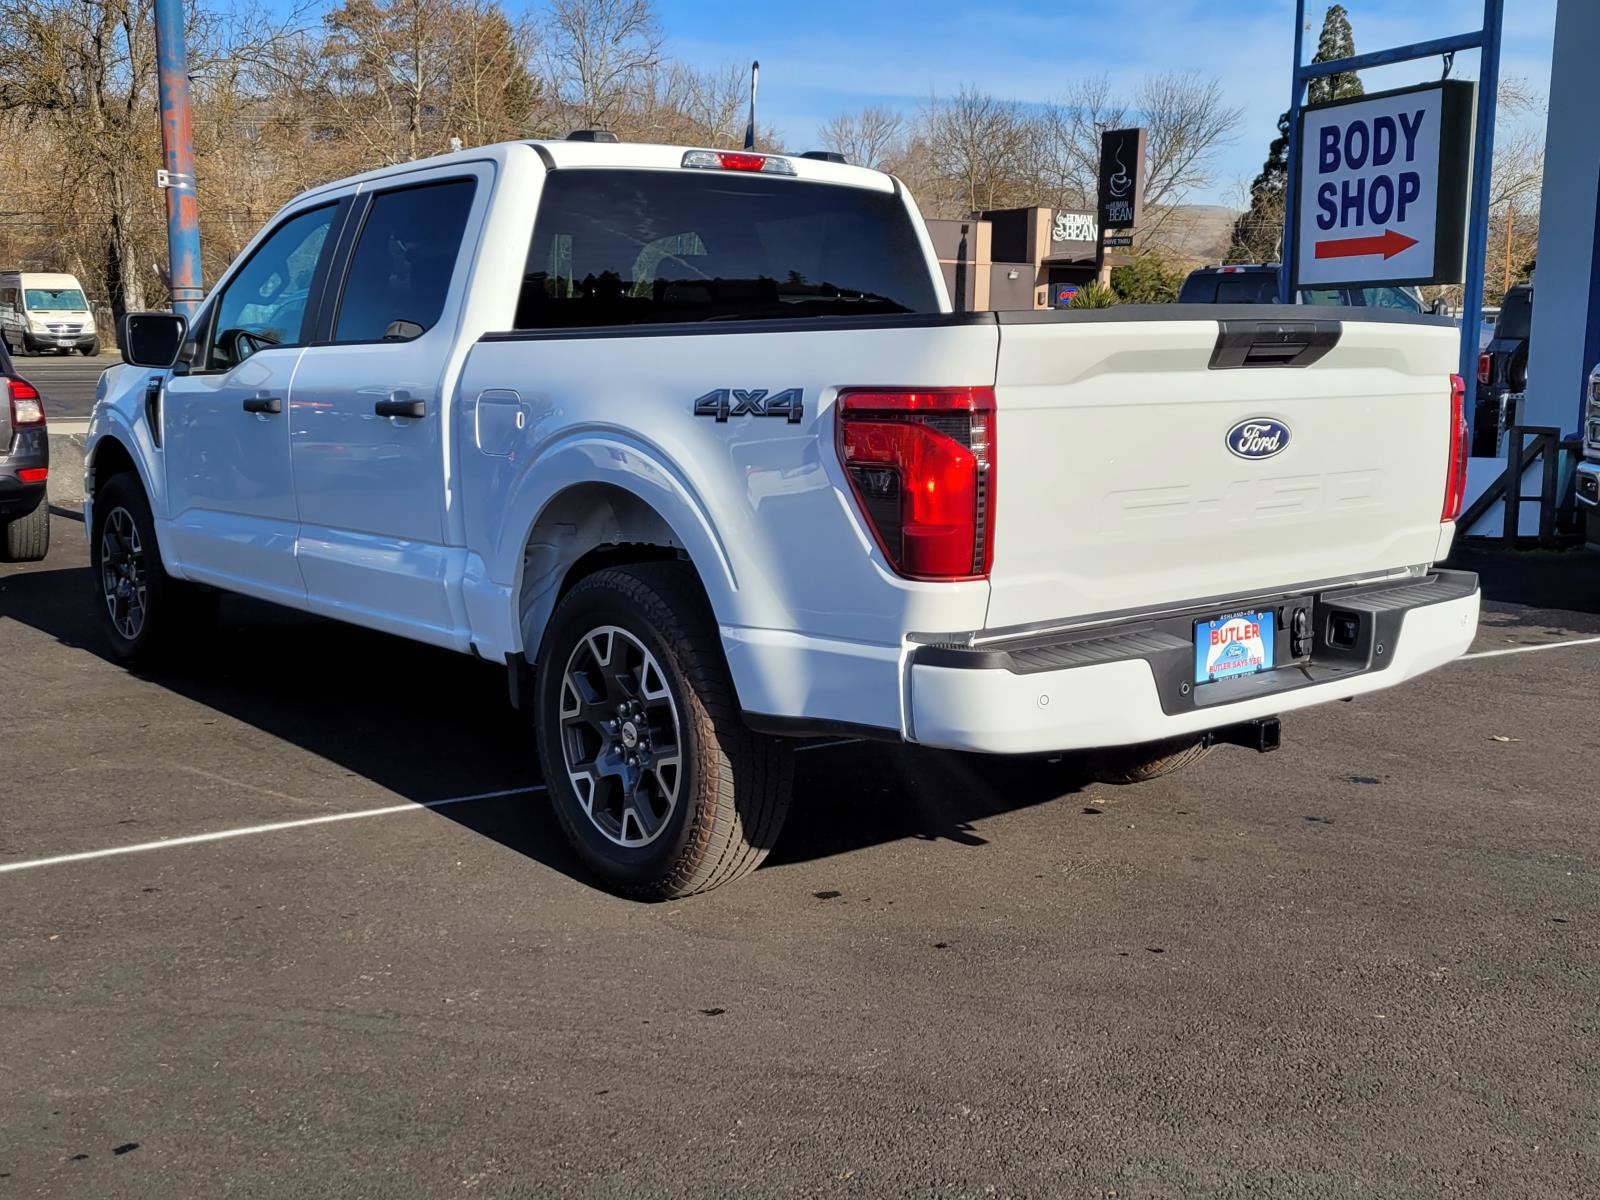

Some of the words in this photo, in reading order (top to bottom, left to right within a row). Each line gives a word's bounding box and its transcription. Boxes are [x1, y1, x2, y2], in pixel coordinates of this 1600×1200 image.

[1319, 109, 1426, 174] BODY
[1110, 201, 1128, 209] HUMAN
[1316, 172, 1420, 230] SHOP
[1066, 214, 1093, 224] HUMAN
[1109, 207, 1132, 221] BEAN
[1065, 224, 1098, 241] BEAN
[694, 388, 804, 424] 4X4
[1238, 424, 1281, 452] Ford
[1211, 623, 1260, 645] BUTLER
[1209, 663, 1231, 673] BUTLER
[1232, 660, 1248, 669] SAYS
[1249, 656, 1262, 665] YES!
